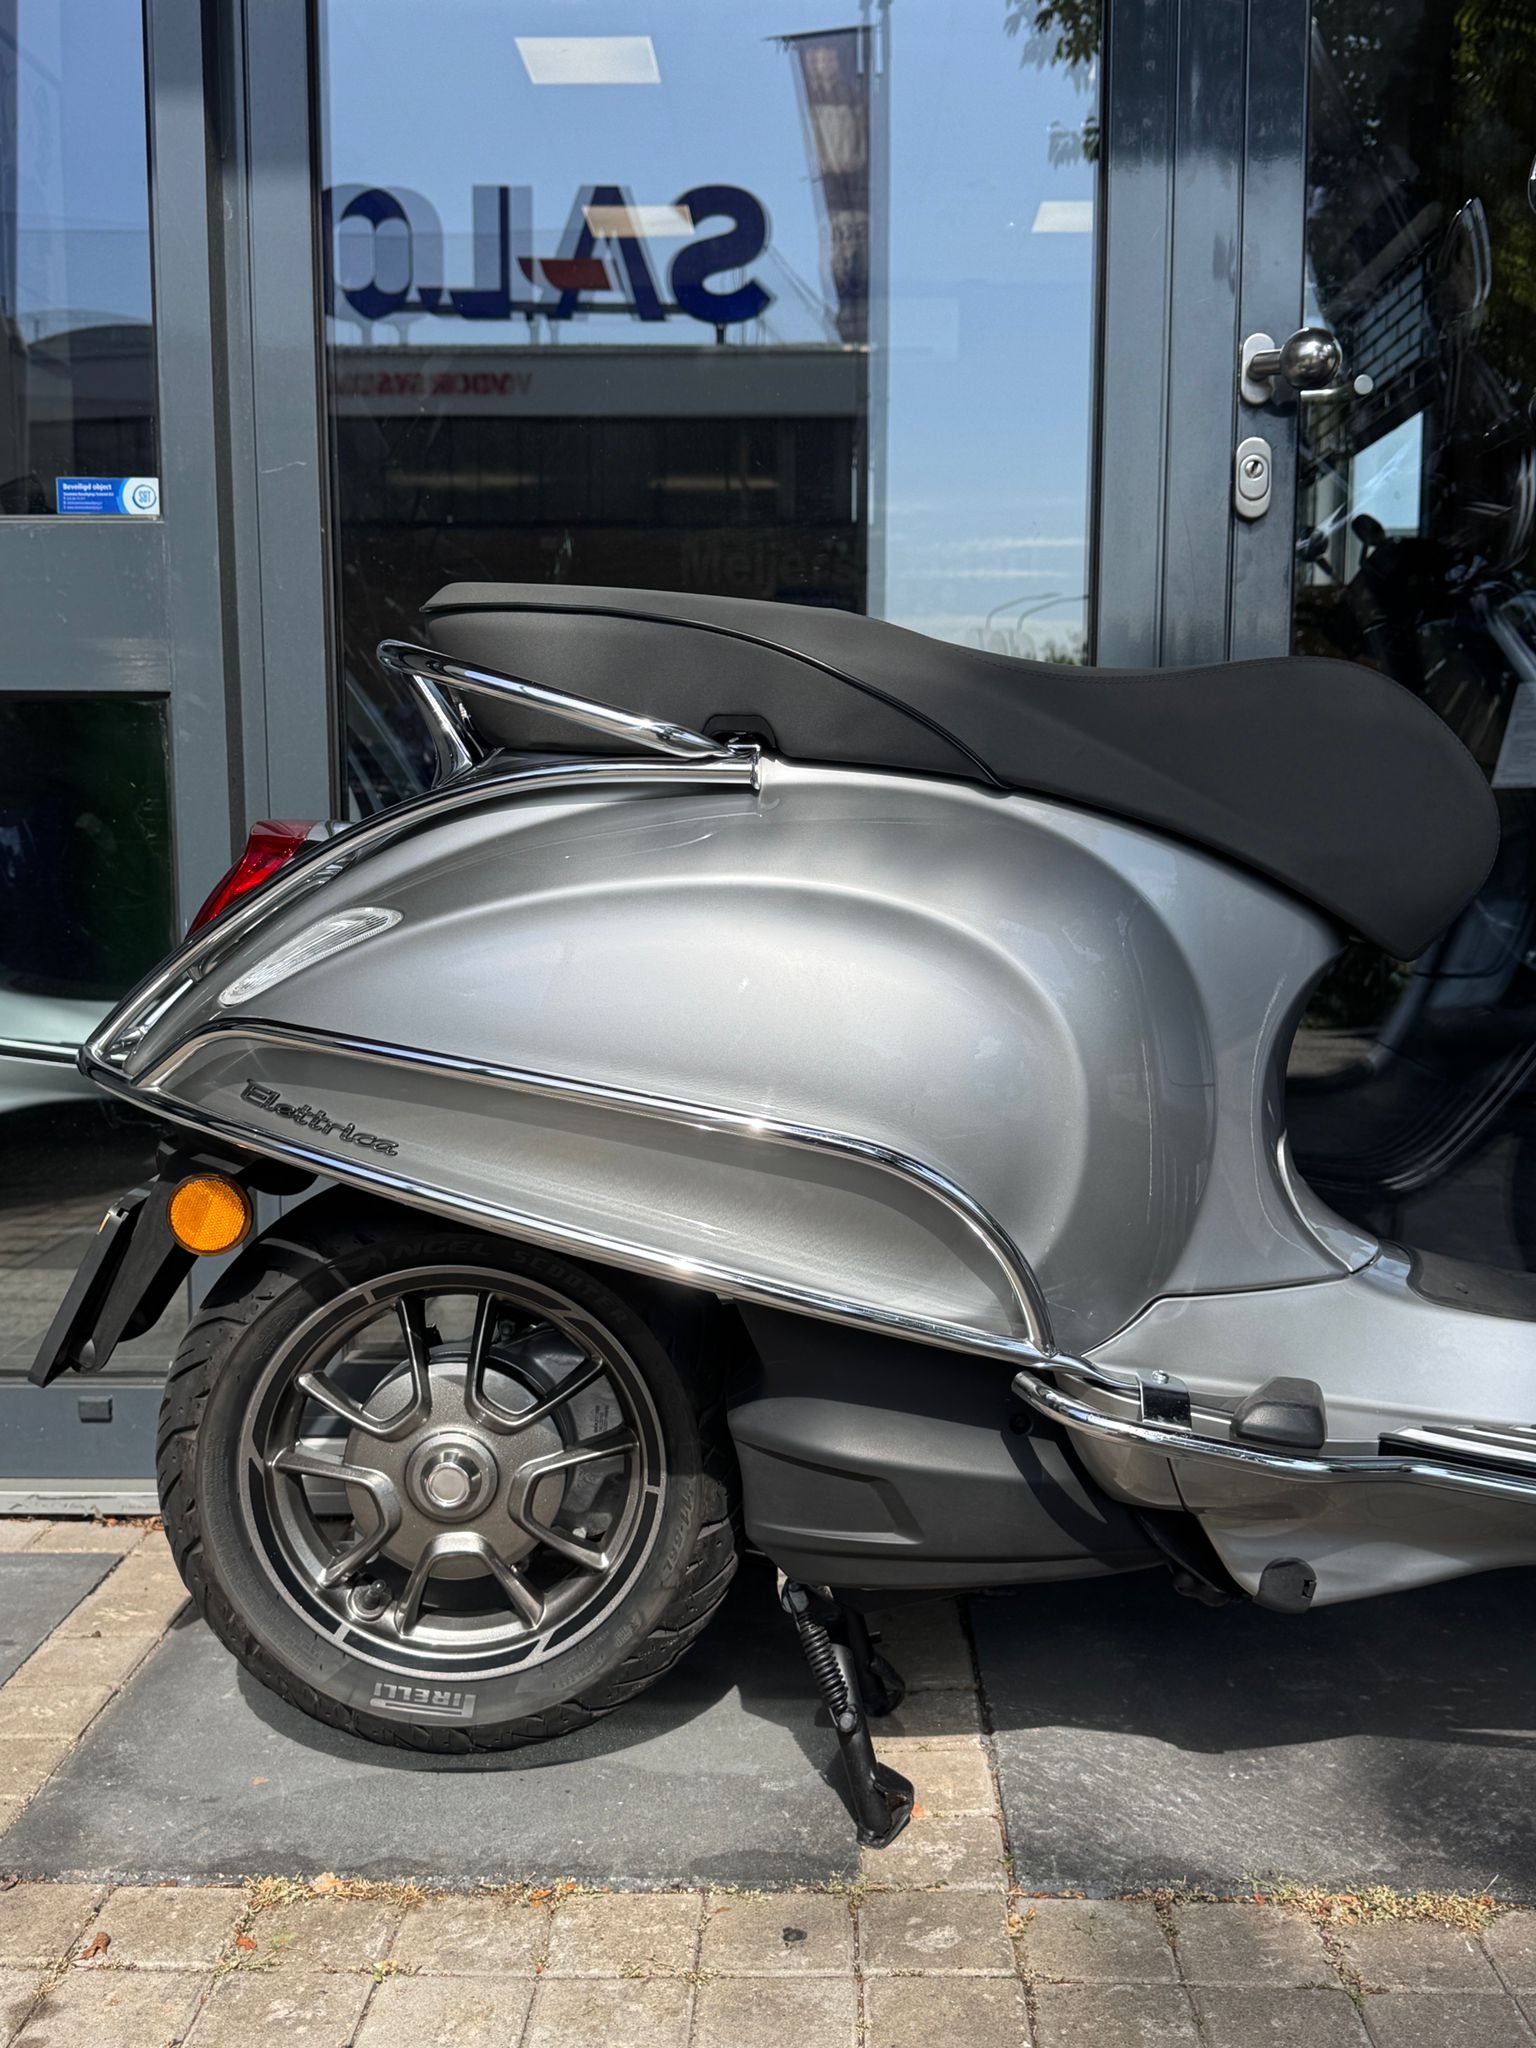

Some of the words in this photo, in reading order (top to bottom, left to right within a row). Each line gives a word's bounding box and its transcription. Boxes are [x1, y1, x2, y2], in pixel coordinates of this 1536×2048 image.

[62, 483, 92, 491] Beveiligd
[92, 483, 112, 491] object
[240, 1078, 399, 1157] Elettrica
[510, 1249, 630, 1324] SCOOTER
[369, 1682, 477, 1718] PIRELLI
